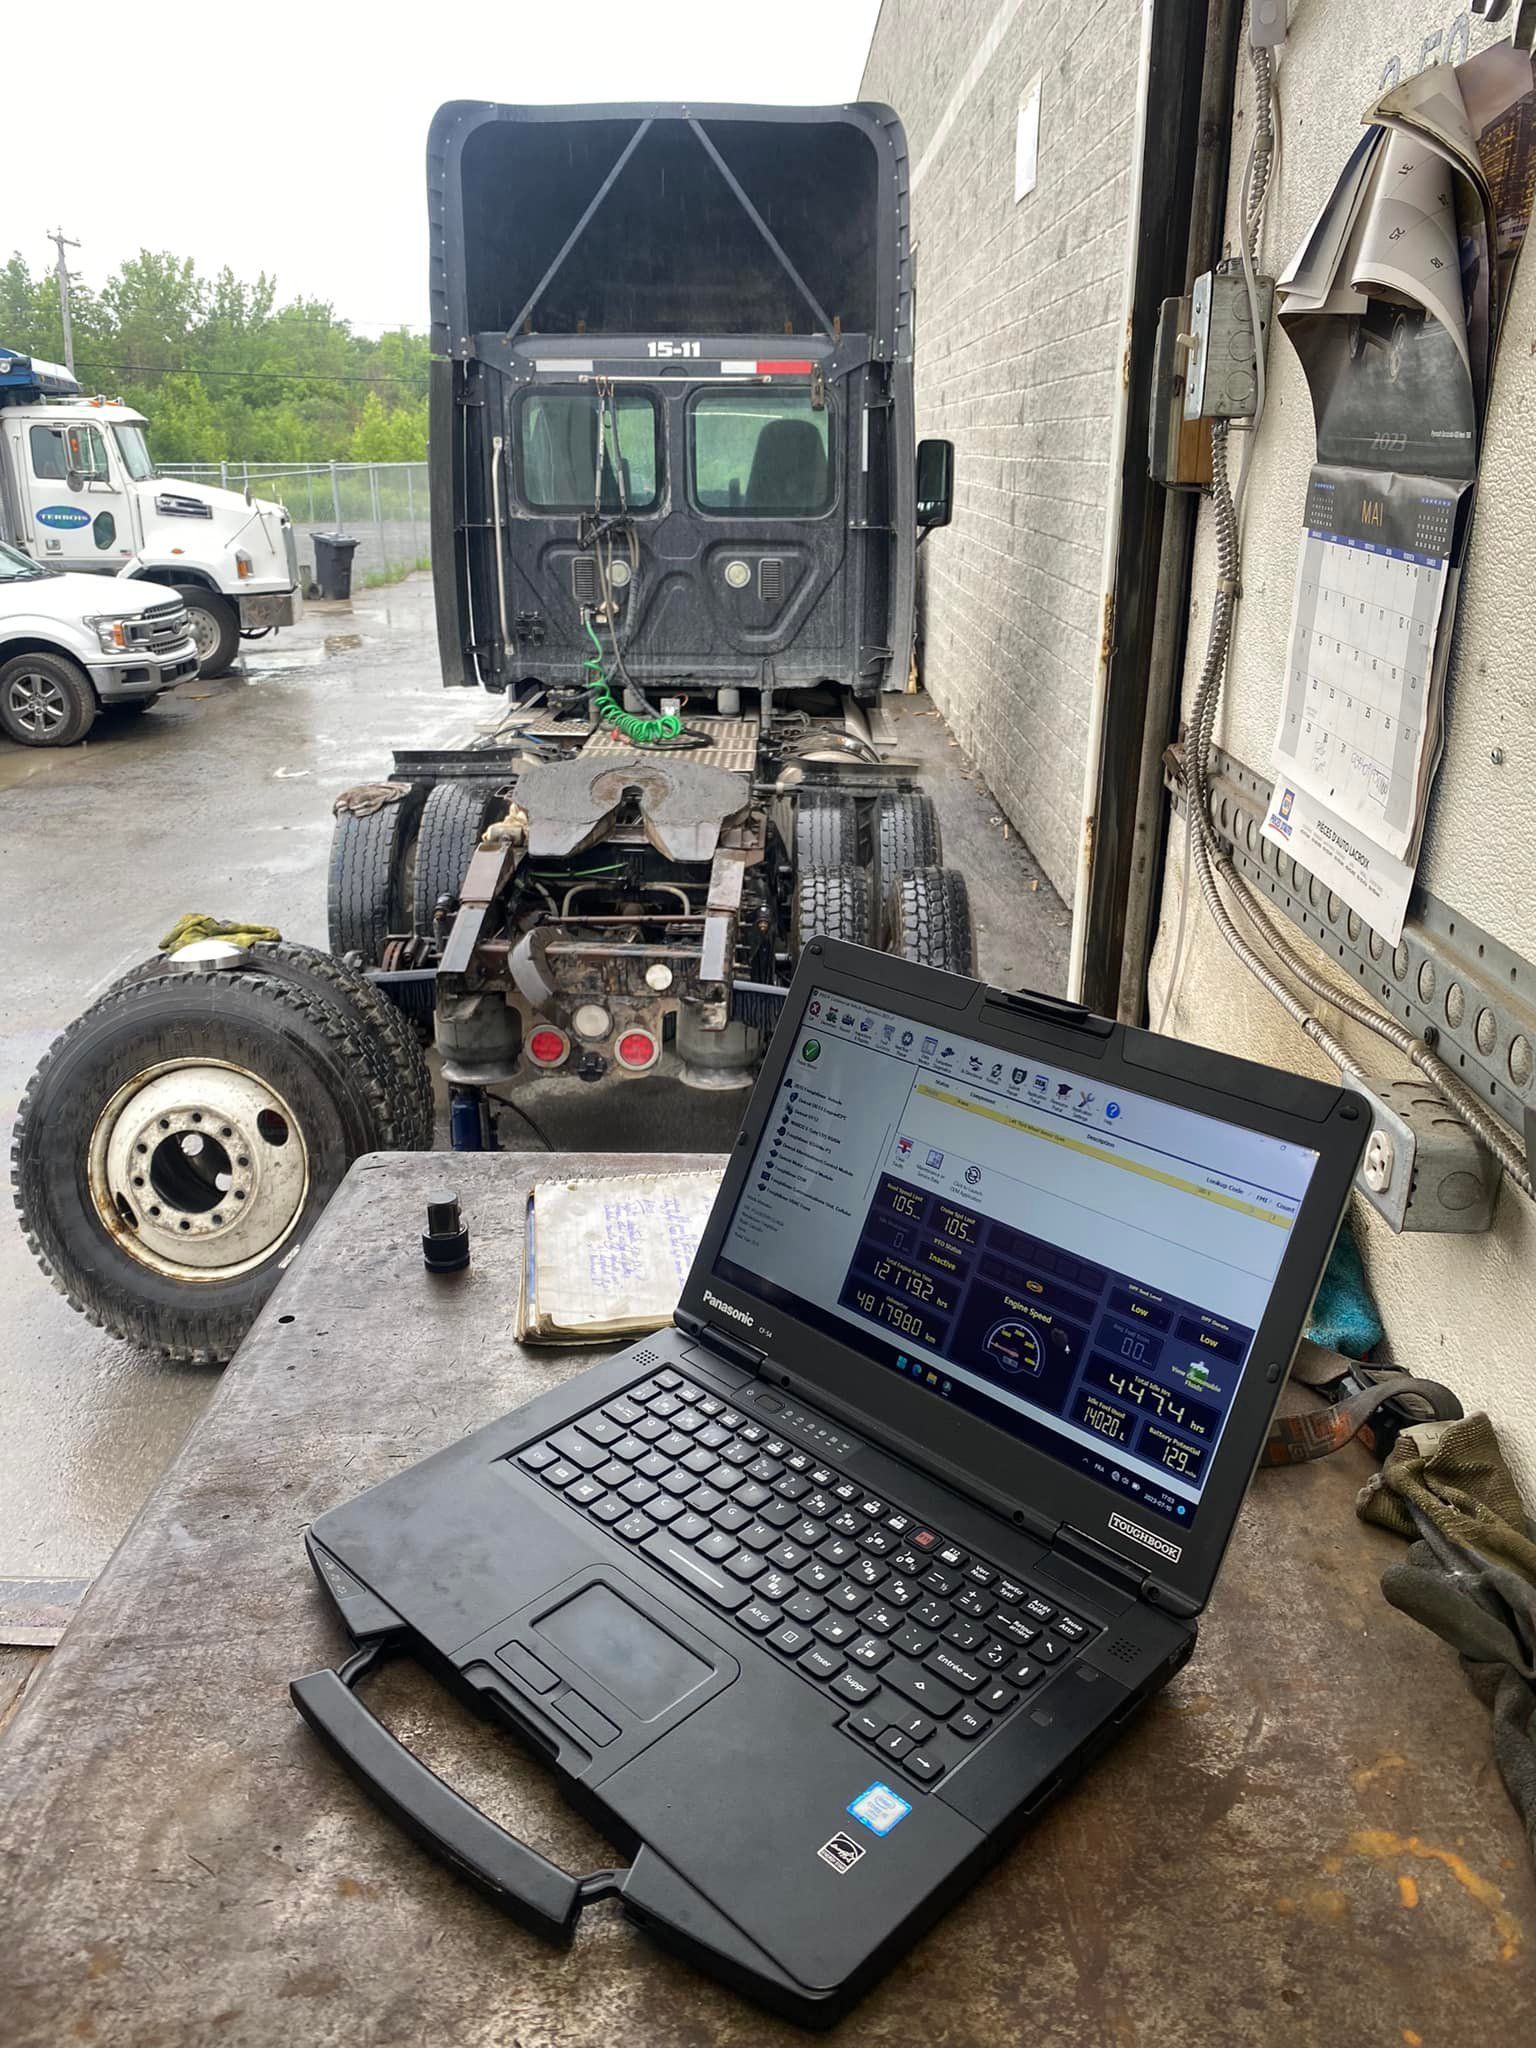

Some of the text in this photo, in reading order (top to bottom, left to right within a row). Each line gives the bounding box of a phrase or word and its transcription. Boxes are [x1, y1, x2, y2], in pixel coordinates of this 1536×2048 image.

[1389, 227, 1406, 241] 25
[648, 341, 700, 357] 15-11
[1370, 431, 1408, 452] 2023
[1361, 500, 1384, 527] MAI
[891, 1193, 915, 1216] 105
[943, 1216, 969, 1240] 105
[928, 1252, 957, 1271] Inactive
[702, 1289, 754, 1327] Panasonic
[935, 1296, 948, 1308] hrs
[1003, 1295, 1052, 1325] Engine Speed
[1130, 1303, 1149, 1318] Low
[924, 1331, 937, 1344] km
[1199, 1333, 1219, 1348] Low
[1134, 1375, 1149, 1387] Total
[1189, 1419, 1206, 1434] hrs
[1148, 1425, 1201, 1456] Battery Potential
[755, 1526, 765, 1534] H
[1112, 1516, 1178, 1559] TOUGHBOOK
[741, 1554, 751, 1563] N
[813, 1565, 823, 1573] K
[769, 1574, 781, 1583] M
[750, 1607, 771, 1623] Alt Gr
[1059, 1624, 1075, 1635] Attn
[1063, 1617, 1083, 1631] Pause
[811, 1652, 832, 1668] Inser
[937, 1654, 964, 1674] Entrée
[843, 1675, 868, 1692] Suppr
[962, 1714, 977, 1727] Fin
